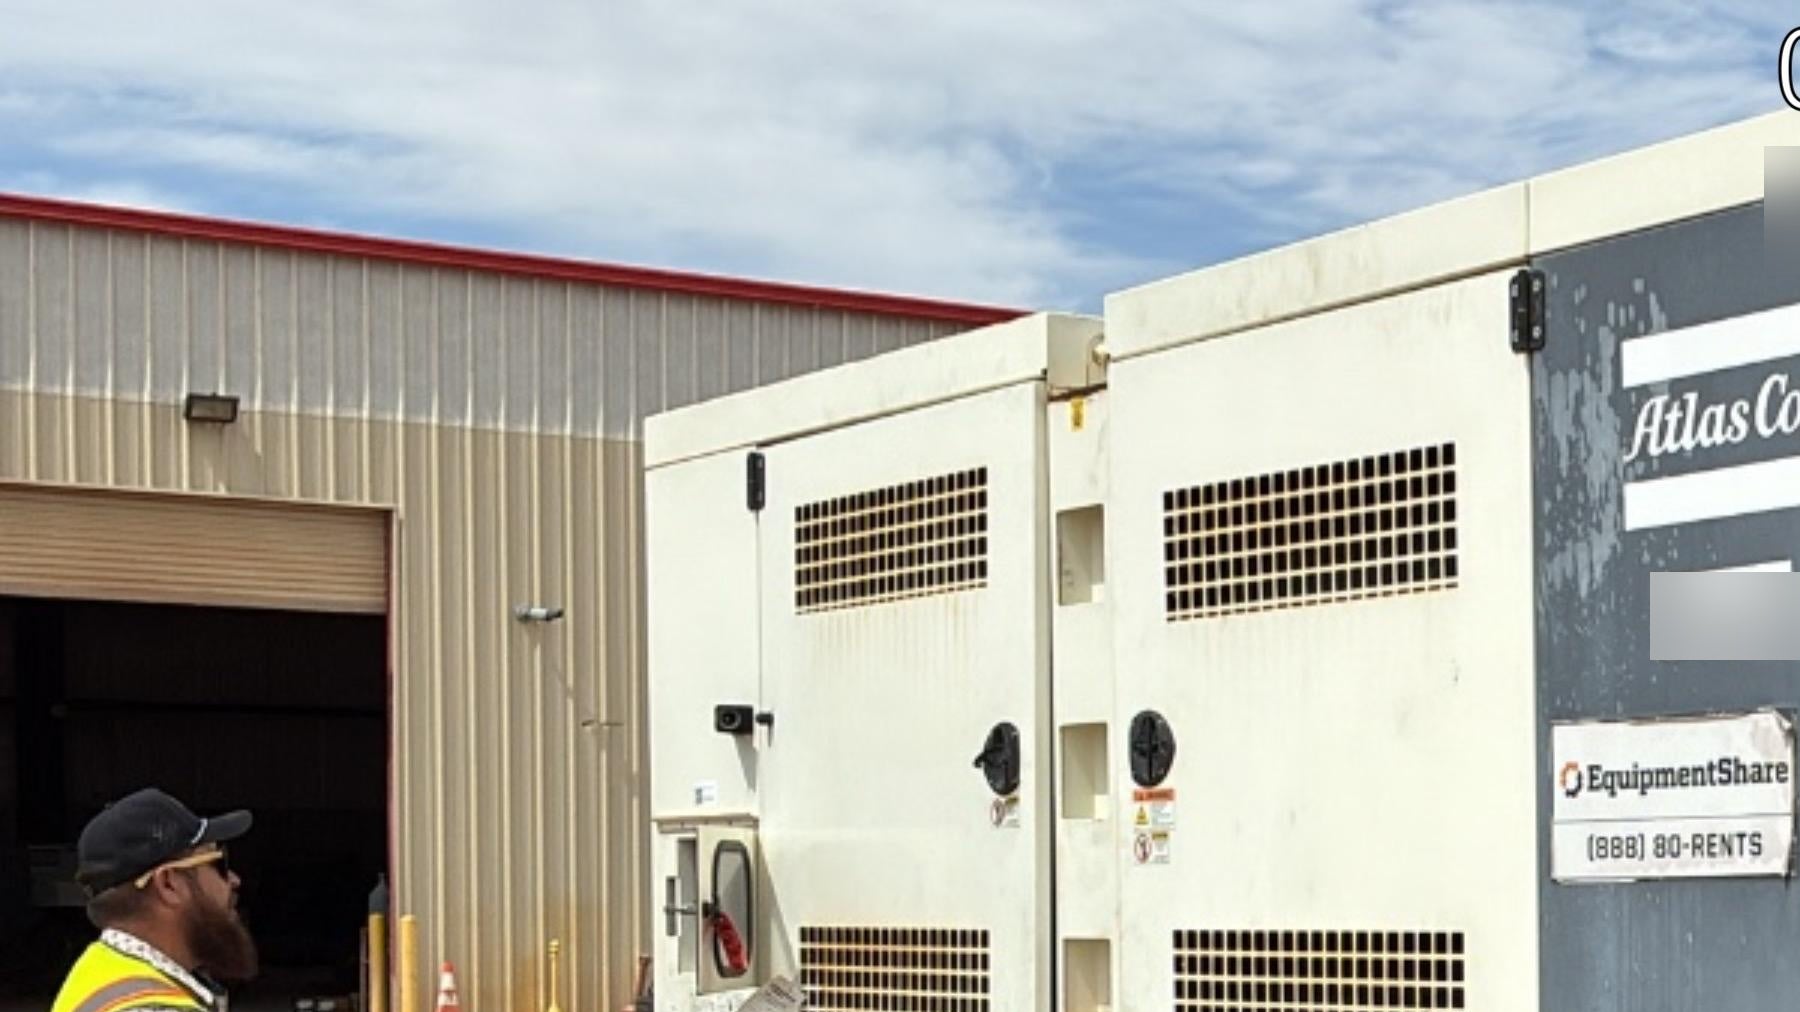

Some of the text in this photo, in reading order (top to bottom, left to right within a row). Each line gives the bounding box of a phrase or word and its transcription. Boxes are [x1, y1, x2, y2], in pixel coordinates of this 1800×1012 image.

[1623, 390, 1750, 463] Atlas
[1586, 756, 1790, 798] EquipmentShare
[1652, 832, 1764, 859] 80-RENTS
